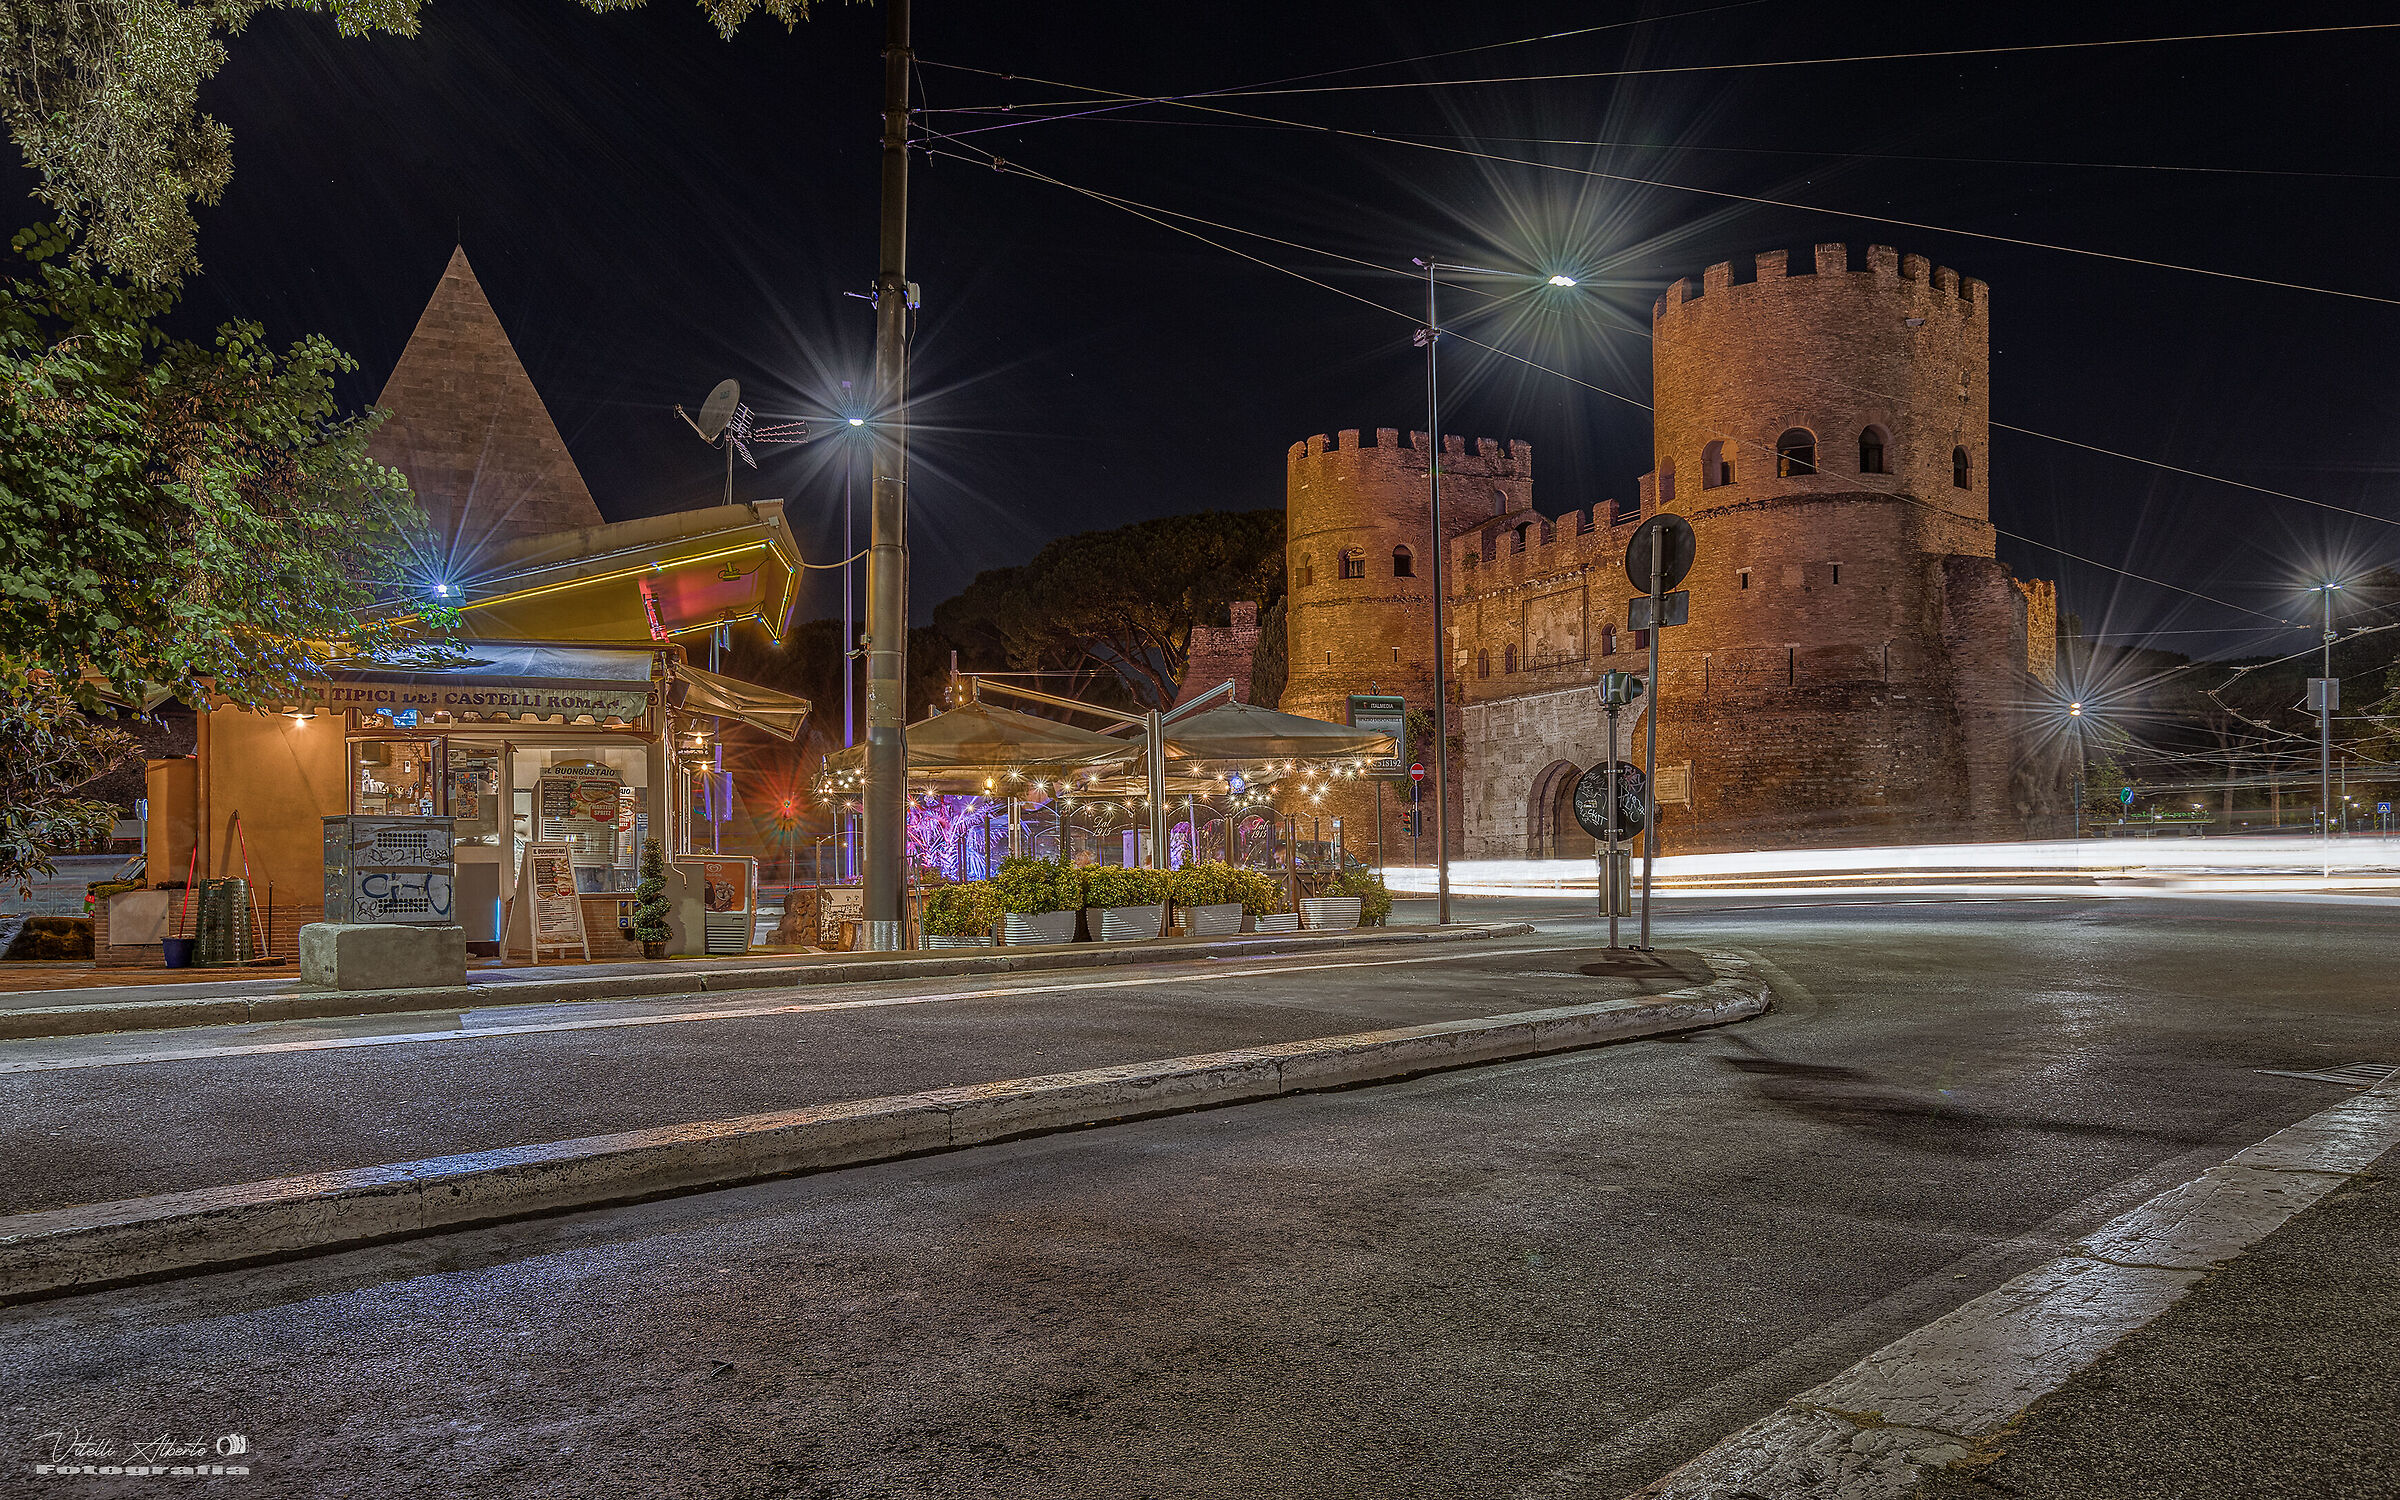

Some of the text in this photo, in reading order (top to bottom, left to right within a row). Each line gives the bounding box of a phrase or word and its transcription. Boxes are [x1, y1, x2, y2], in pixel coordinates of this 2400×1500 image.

[332, 687, 396, 703] TIPICI
[444, 692, 541, 707] CASTELLI
[546, 695, 627, 710] ROMAN
[555, 767, 615, 776] BUONGUSTAIO
[1092, 826, 1112, 837] 1915
[1251, 829, 1268, 839] 1915
